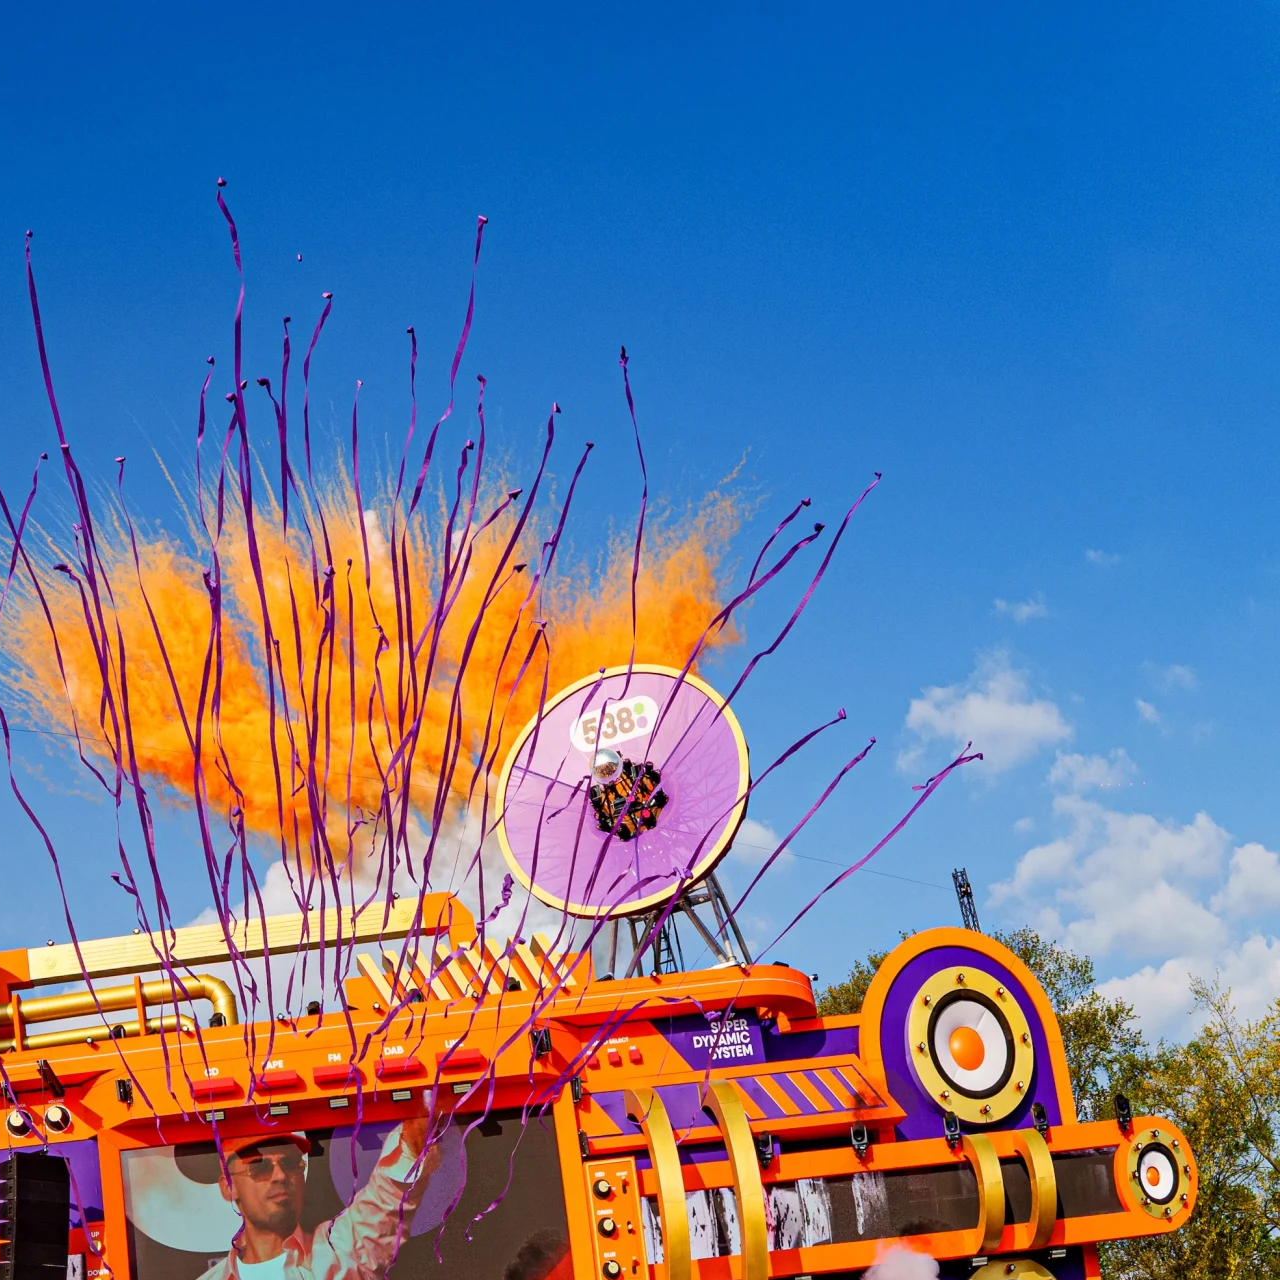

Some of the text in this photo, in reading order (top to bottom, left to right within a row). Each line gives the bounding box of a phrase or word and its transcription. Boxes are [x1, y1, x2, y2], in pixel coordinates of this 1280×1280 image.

[581, 706, 636, 745] 538
[710, 1018, 749, 1034] SUPER
[692, 1031, 751, 1049] DYNAMIC
[327, 1053, 342, 1063] FM
[384, 1046, 405, 1056] DAB
[708, 1044, 754, 1060] SYSTEM
[204, 1067, 219, 1077] CD
